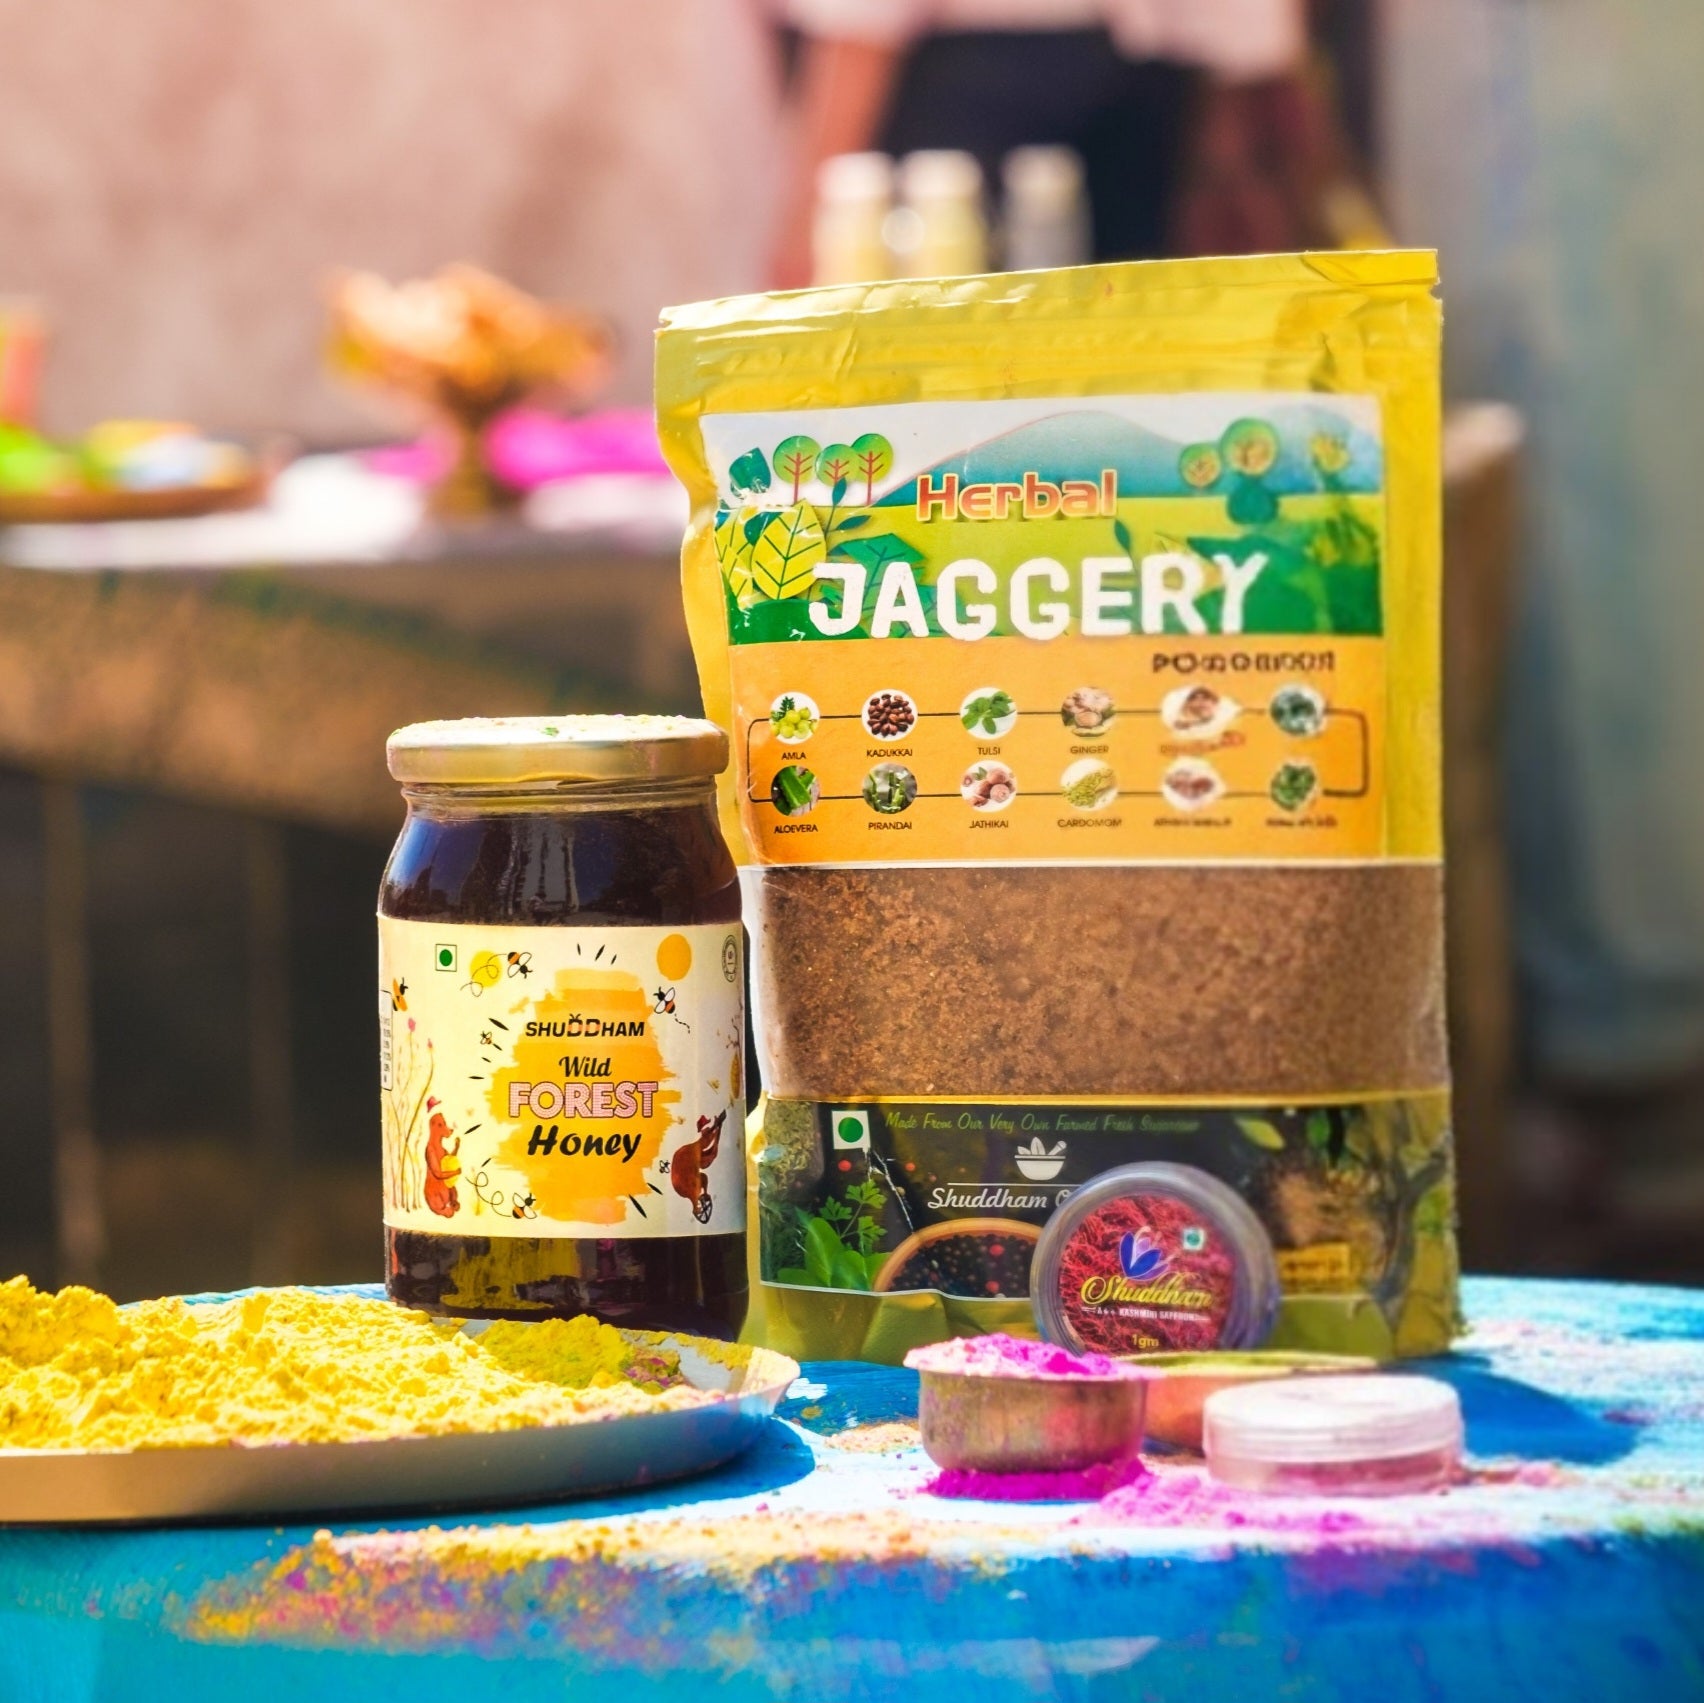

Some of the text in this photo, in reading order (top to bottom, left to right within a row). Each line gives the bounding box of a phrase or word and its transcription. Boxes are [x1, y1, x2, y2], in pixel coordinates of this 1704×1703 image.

[916, 470, 1118, 522] Herbal
[808, 552, 1269, 641] JAGGERY
[781, 751, 806, 761] AMLA
[866, 748, 913, 758] KADUKKAI
[977, 747, 1001, 756] TULSI
[1070, 745, 1109, 754] GINGER
[774, 824, 818, 835] ALOEVERA
[868, 821, 913, 831] PIRANDAI
[969, 820, 1009, 829] JATHIKAI
[525, 1015, 645, 1037] SHUDDHAM
[558, 1056, 612, 1077] Wild
[508, 1081, 659, 1119] FOREST
[885, 1111, 917, 1129] Made
[923, 1112, 952, 1129] From
[957, 1112, 984, 1130] Our
[990, 1113, 1014, 1134] Very
[1021, 1113, 1050, 1130] Own
[527, 1124, 642, 1164] Honey
[927, 1187, 1048, 1209] Shuddham
[1131, 1334, 1159, 1349] 1gm
